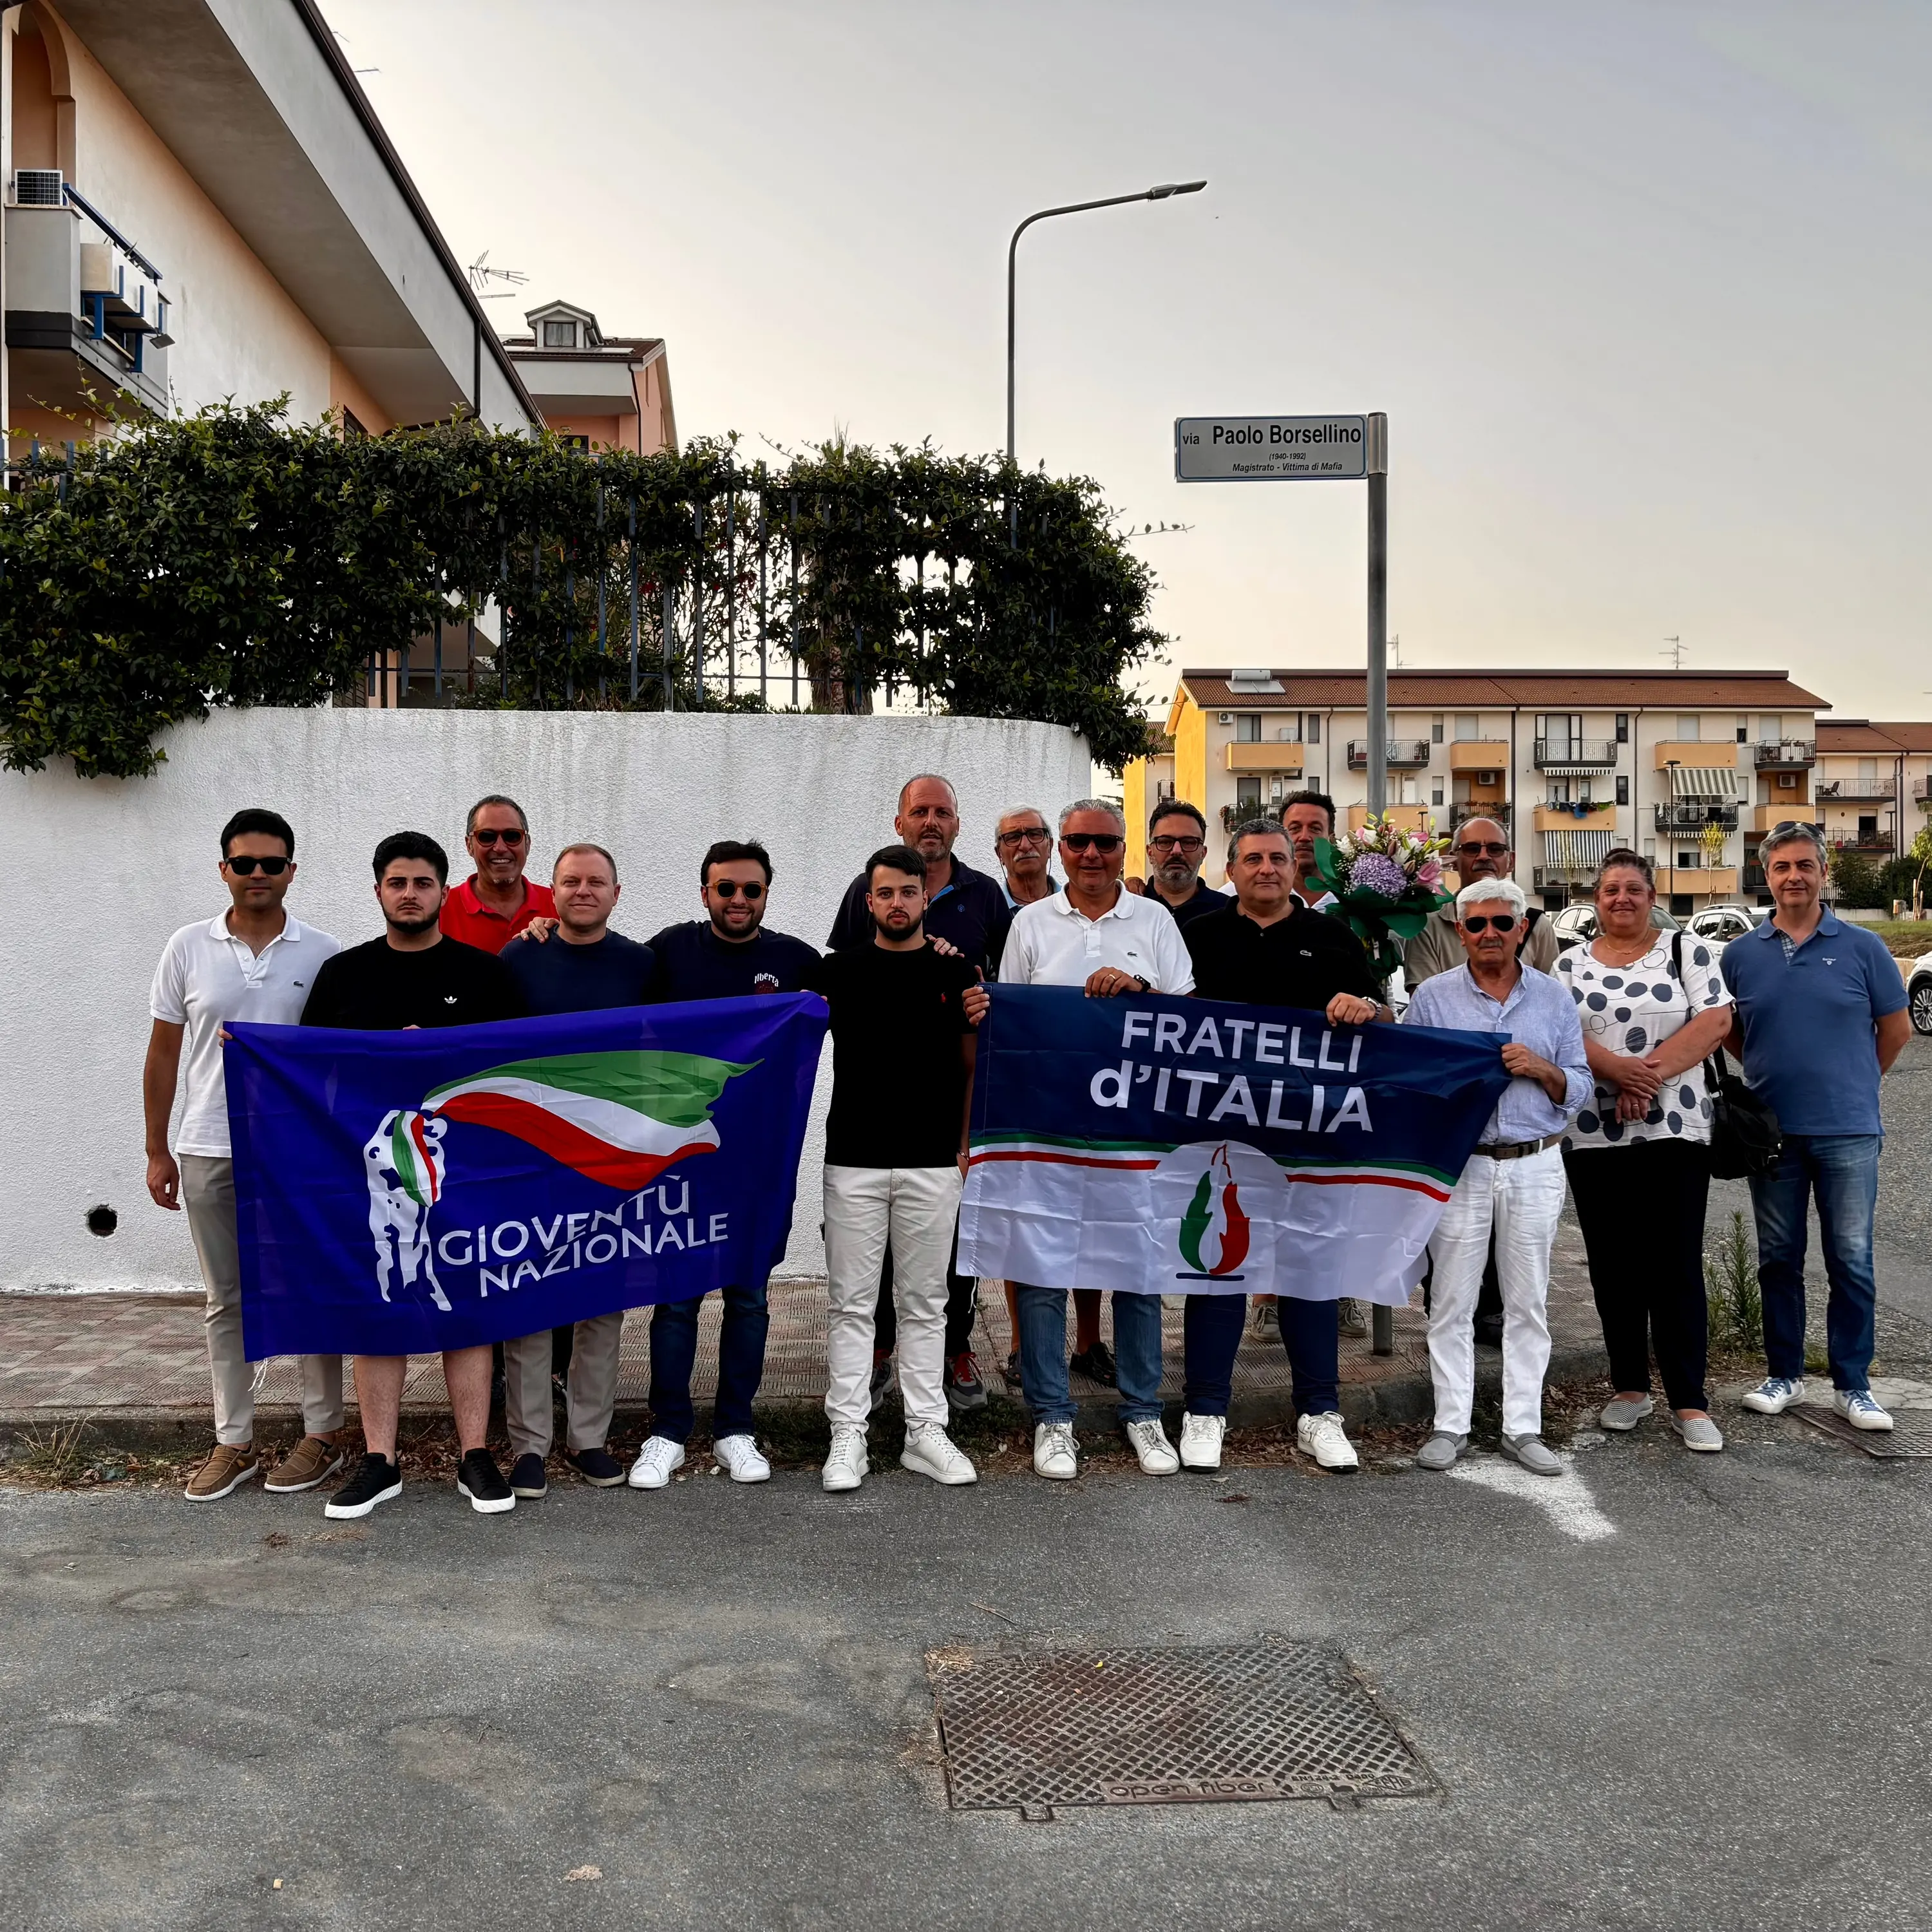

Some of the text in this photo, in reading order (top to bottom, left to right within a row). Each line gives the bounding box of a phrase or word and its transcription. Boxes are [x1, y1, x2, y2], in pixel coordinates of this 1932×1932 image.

[1182, 424, 1361, 444] via Paolo Borsellino
[1232, 463, 1274, 473] Magistrato
[1282, 462, 1309, 471] Vittima
[1311, 462, 1319, 471] di
[1320, 462, 1343, 471] Mafia
[1269, 452, 1306, 462] (1940-1992)
[1121, 1010, 1363, 1073] FRATELLI
[1090, 1060, 1373, 1133] d'ITALIA
[438, 1175, 689, 1265] GIOVENTÙ
[479, 1213, 729, 1298] NAZIONALE
[1110, 1781, 1264, 1799] open fiber
